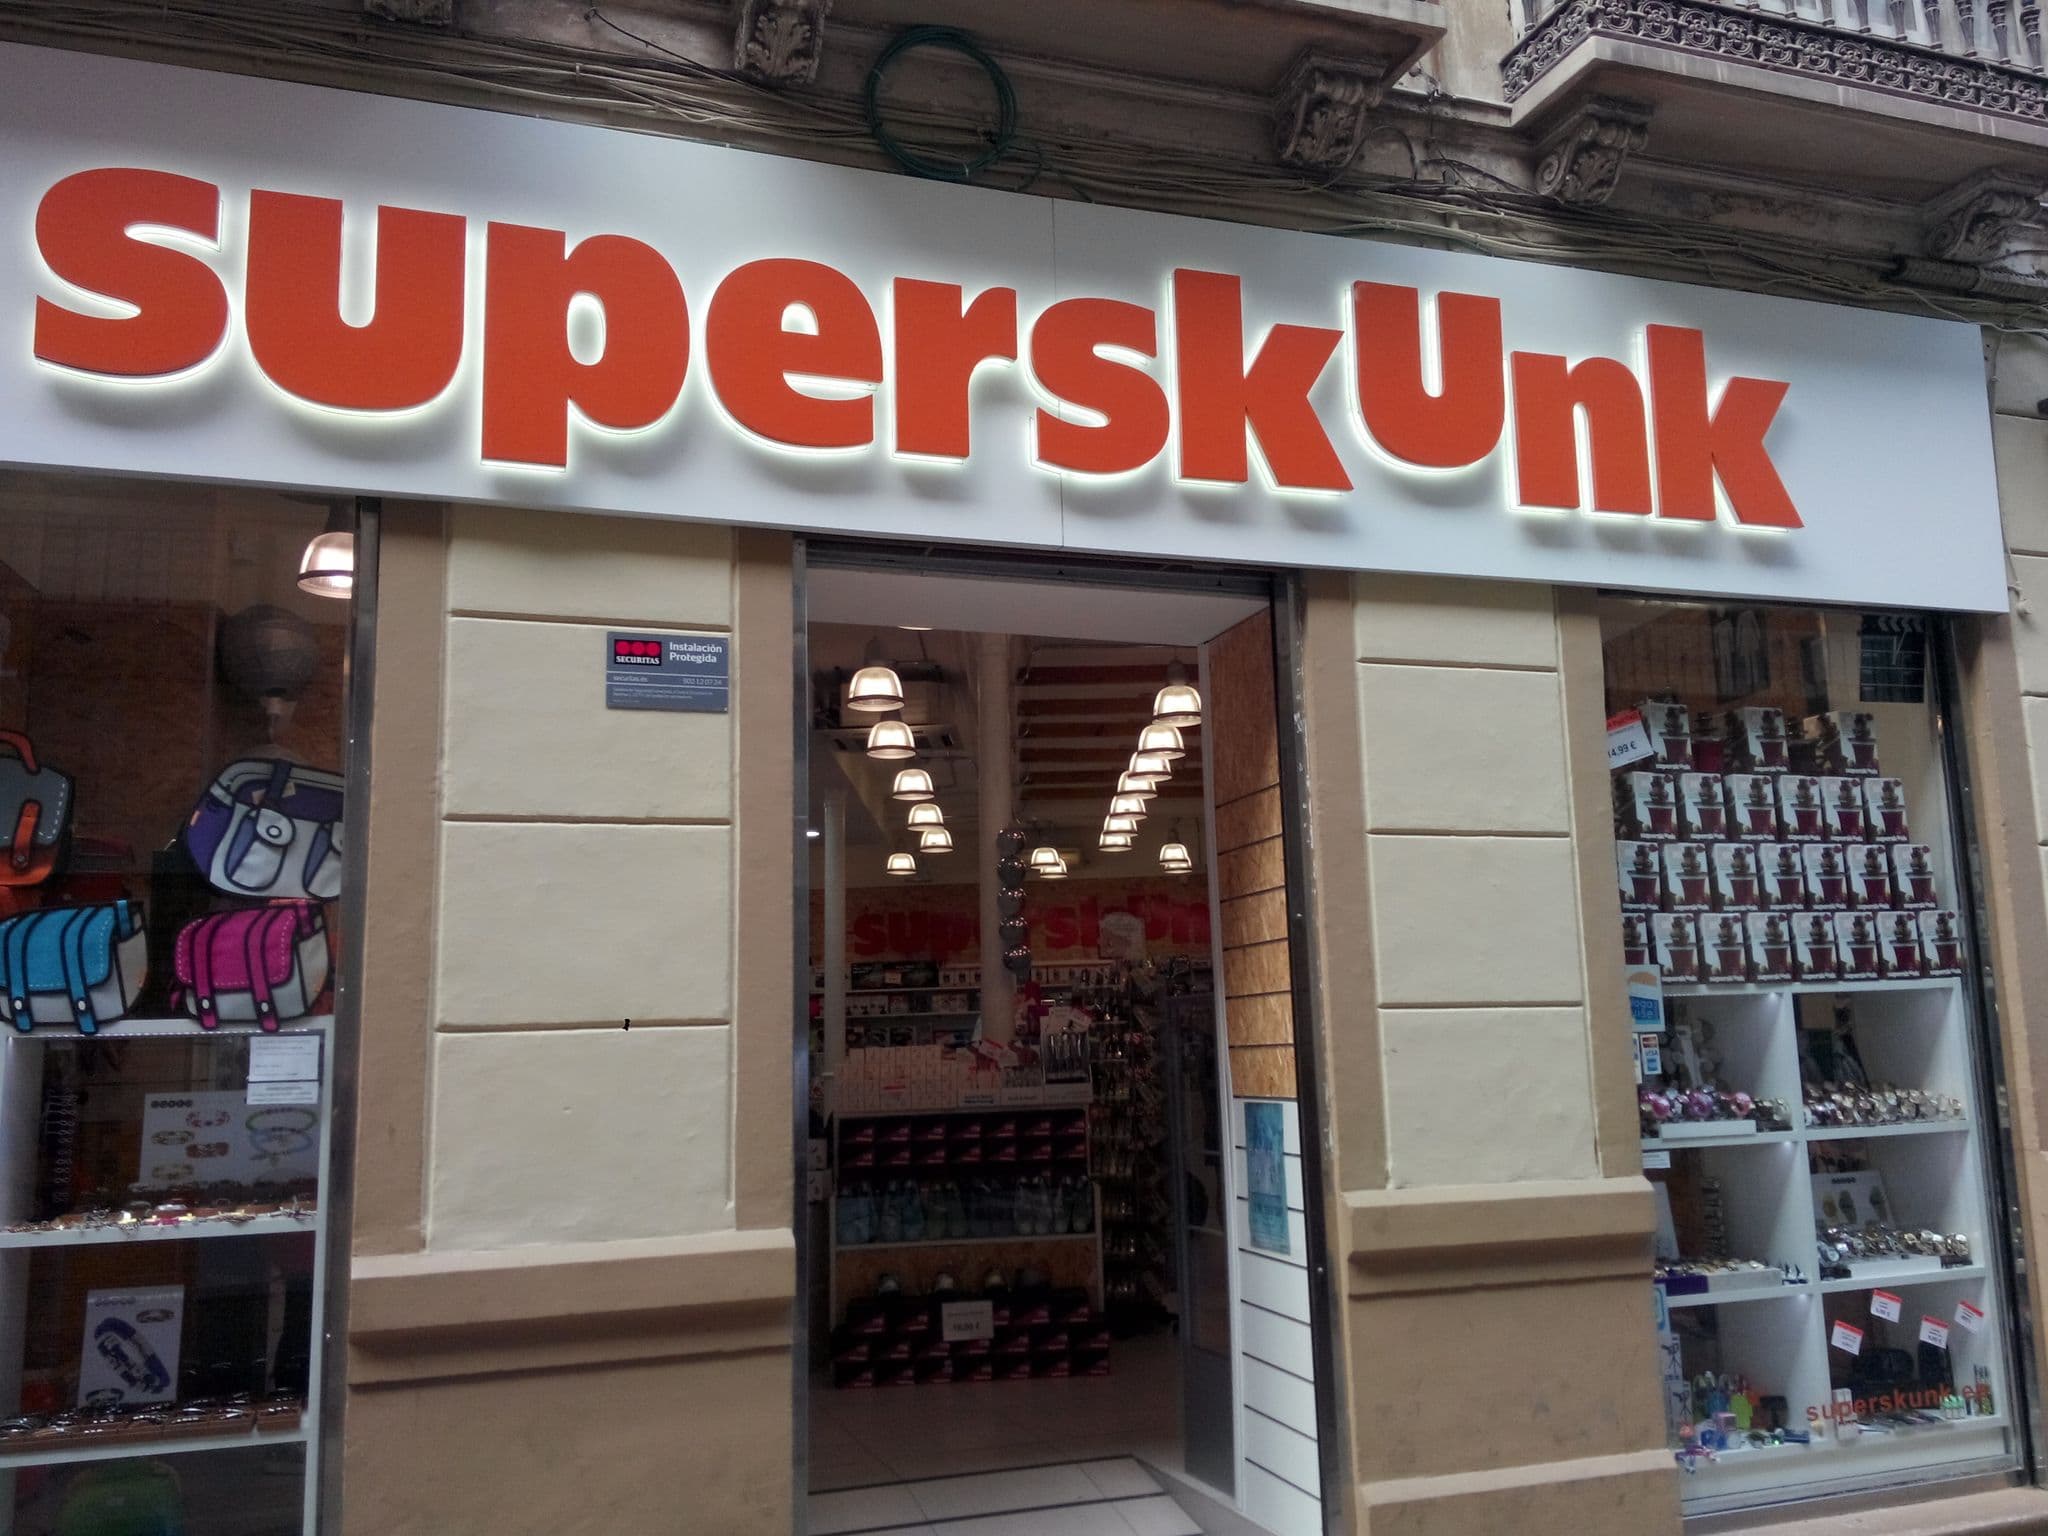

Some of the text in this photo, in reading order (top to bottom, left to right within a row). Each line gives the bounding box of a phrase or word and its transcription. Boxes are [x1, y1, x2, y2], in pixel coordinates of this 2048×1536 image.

[669, 641, 722, 653] Instalación
[616, 656, 659, 665] SECURITAS
[669, 652, 717, 664] Protegida
